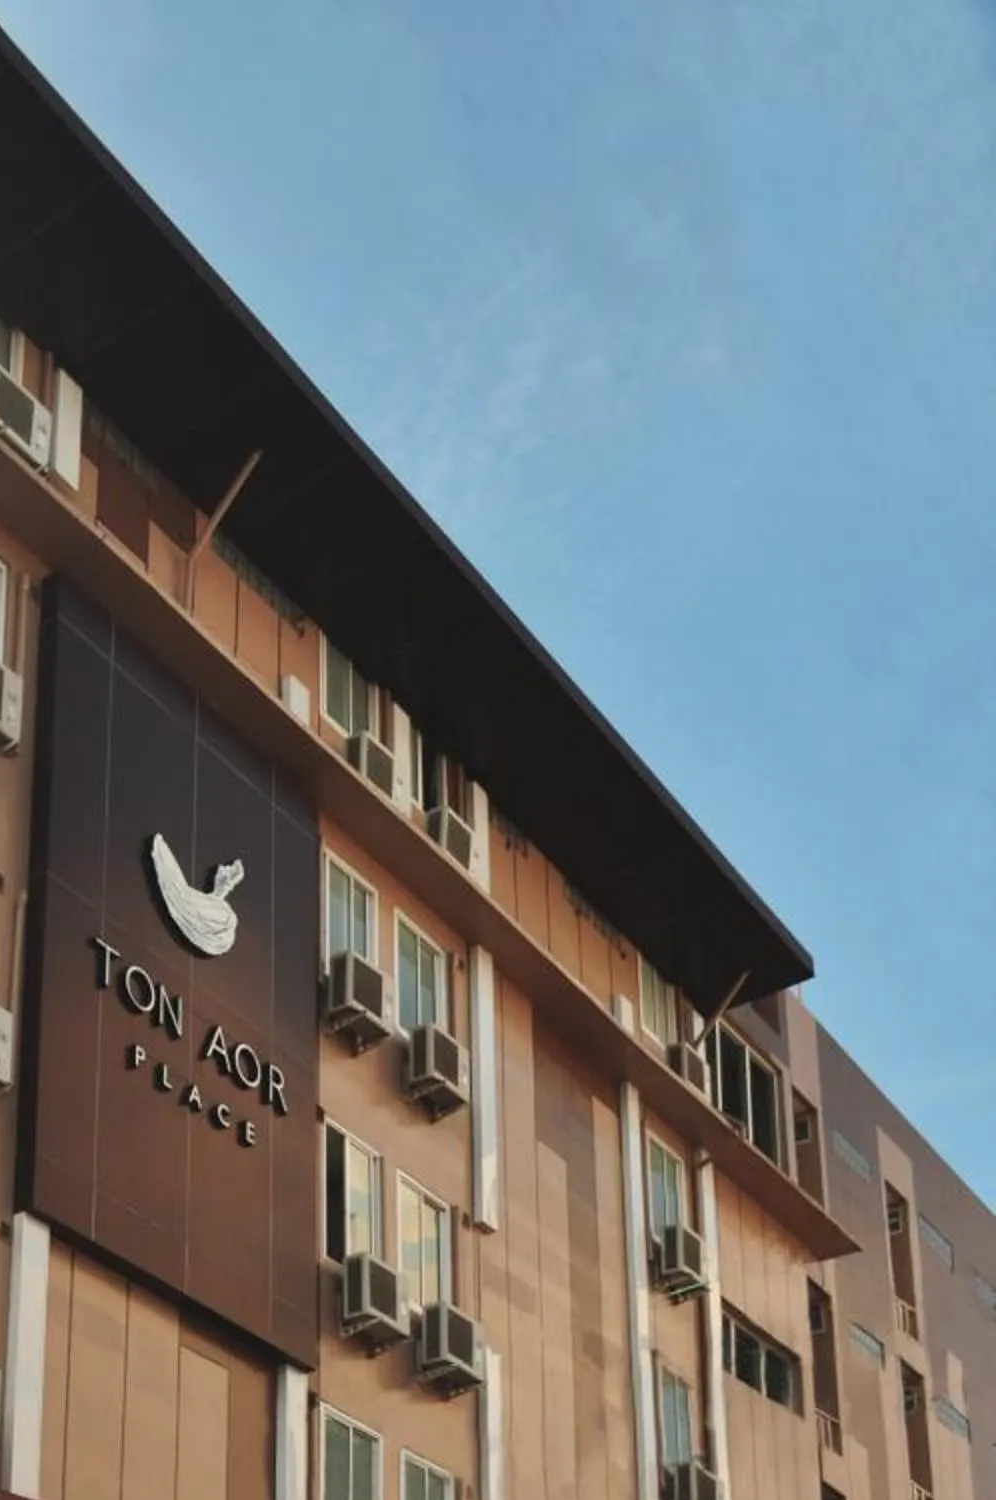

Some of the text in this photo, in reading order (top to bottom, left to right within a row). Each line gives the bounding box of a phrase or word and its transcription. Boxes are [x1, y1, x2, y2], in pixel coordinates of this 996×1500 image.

[95, 936, 288, 1112] TON AOR
[134, 1045, 256, 1145] PLACE
